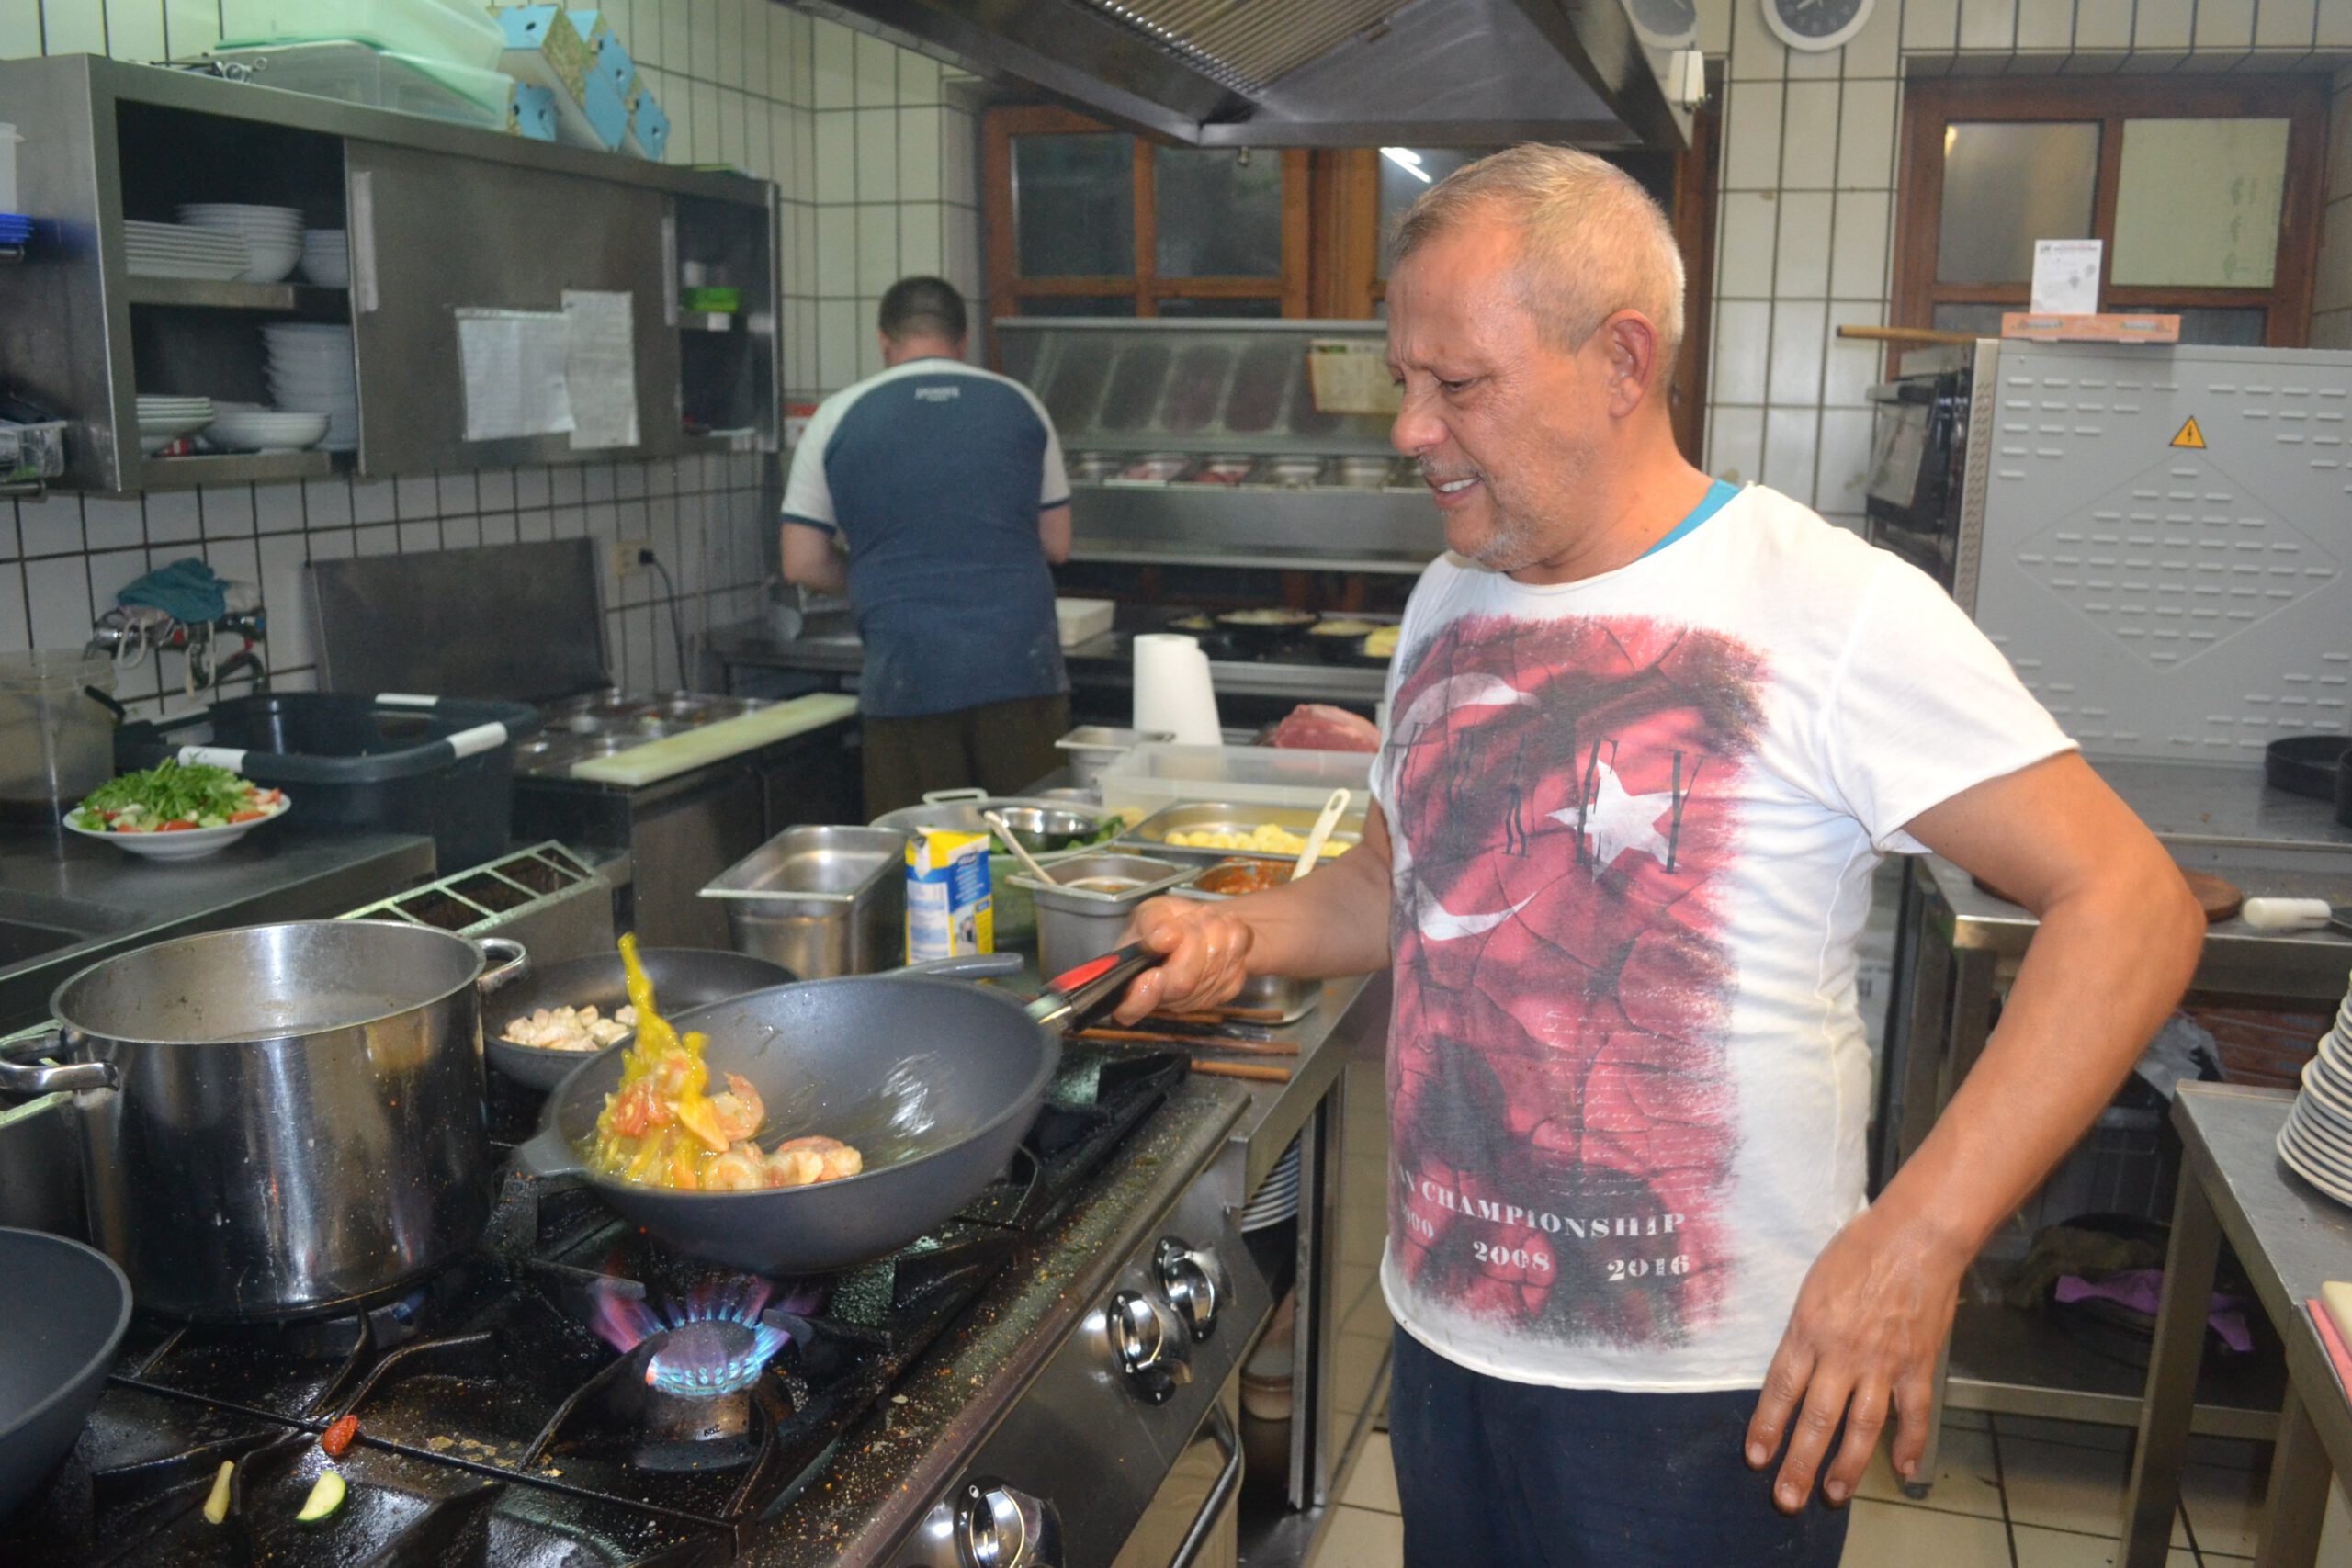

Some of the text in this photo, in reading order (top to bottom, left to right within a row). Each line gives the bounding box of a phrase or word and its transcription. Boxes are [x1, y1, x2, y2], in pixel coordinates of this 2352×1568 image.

[1421, 1180, 1686, 1239] CHAMPIONSHIP
[1473, 1241, 1550, 1272] 2008
[1607, 1254, 1690, 1282] 2016
